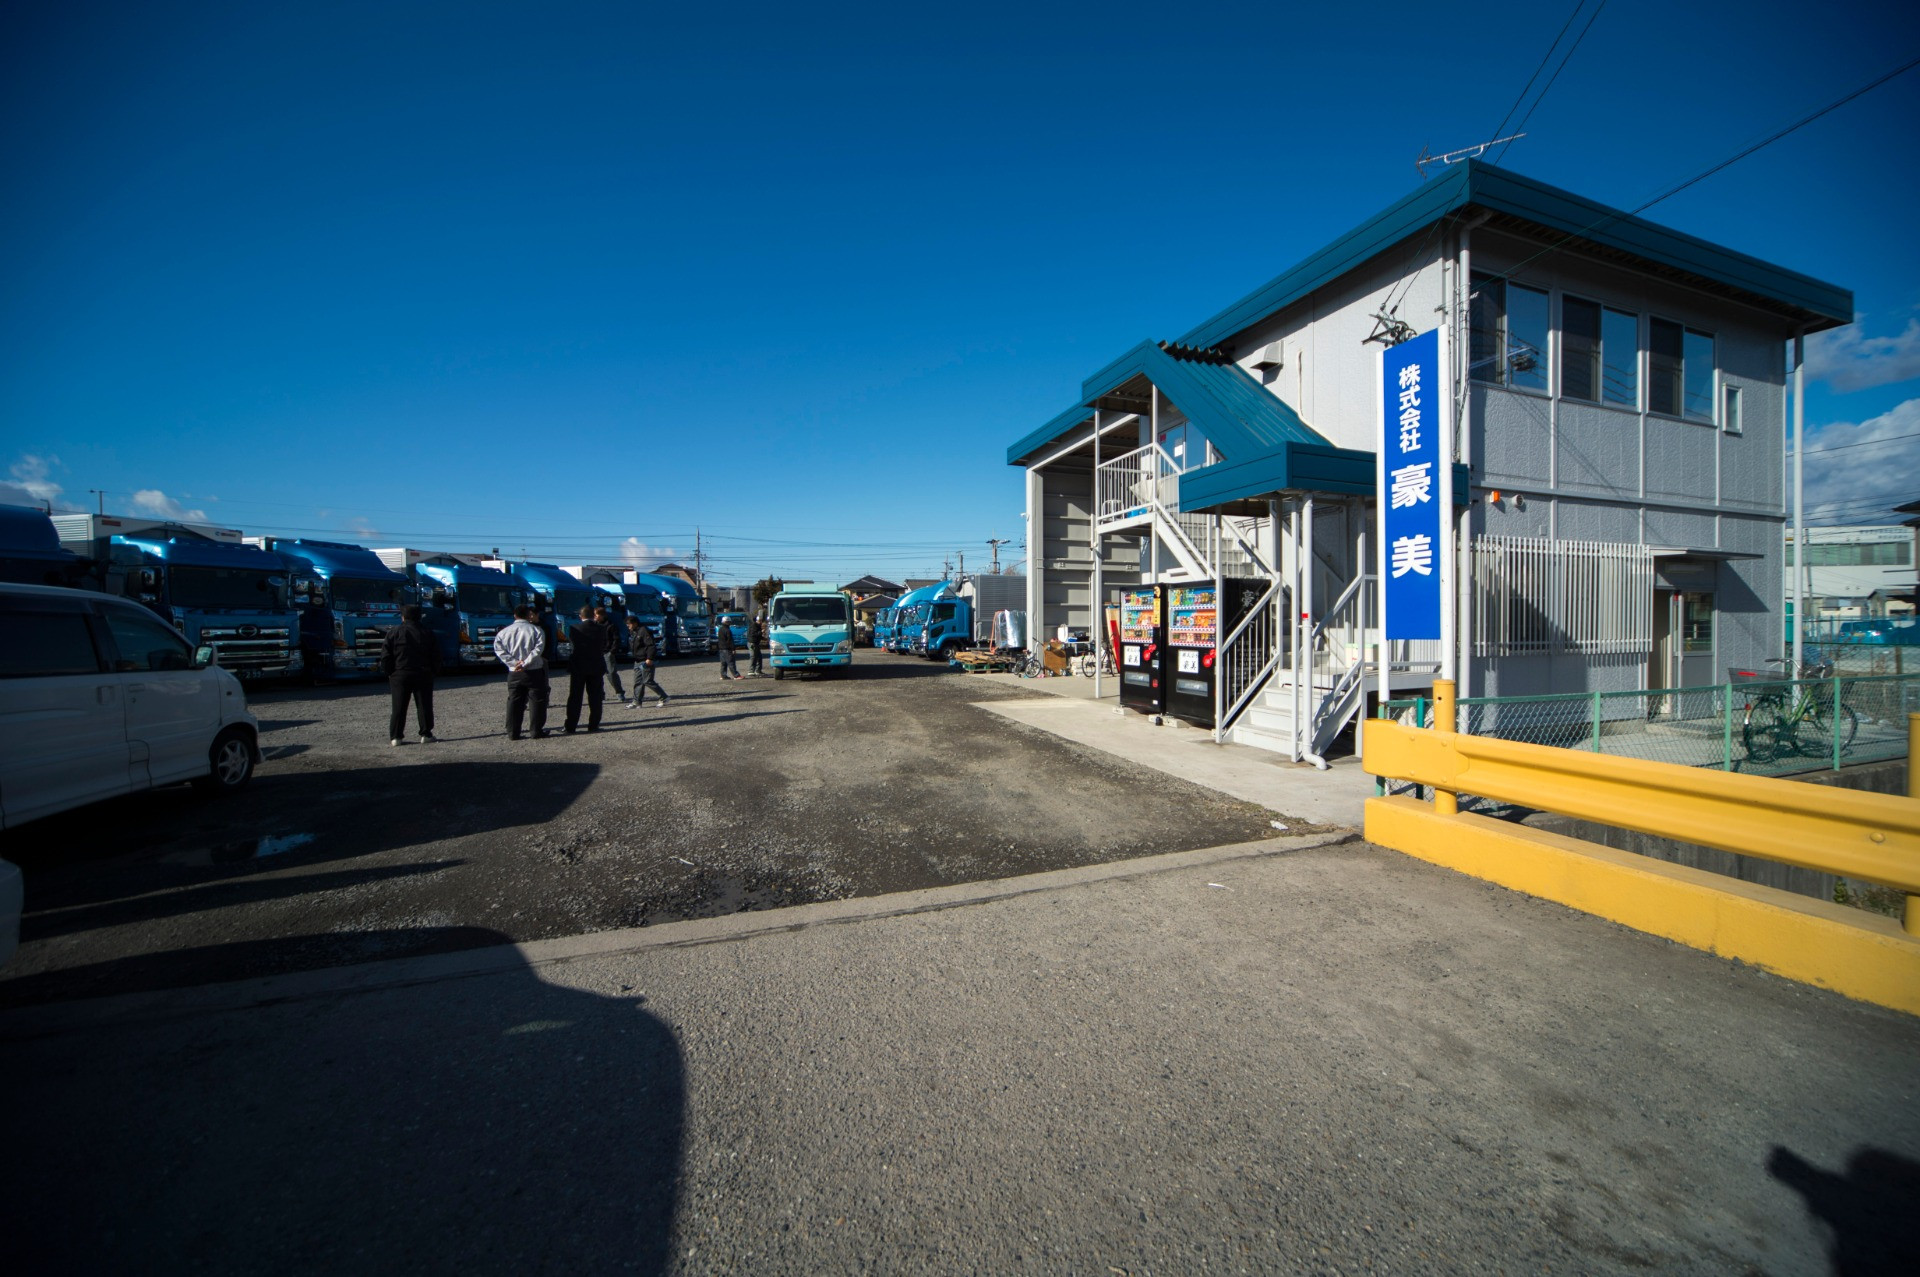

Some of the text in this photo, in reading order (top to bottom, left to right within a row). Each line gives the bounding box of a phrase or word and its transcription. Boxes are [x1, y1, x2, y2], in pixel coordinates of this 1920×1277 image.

[1390, 363, 1432, 579] 株式会社 豪美
